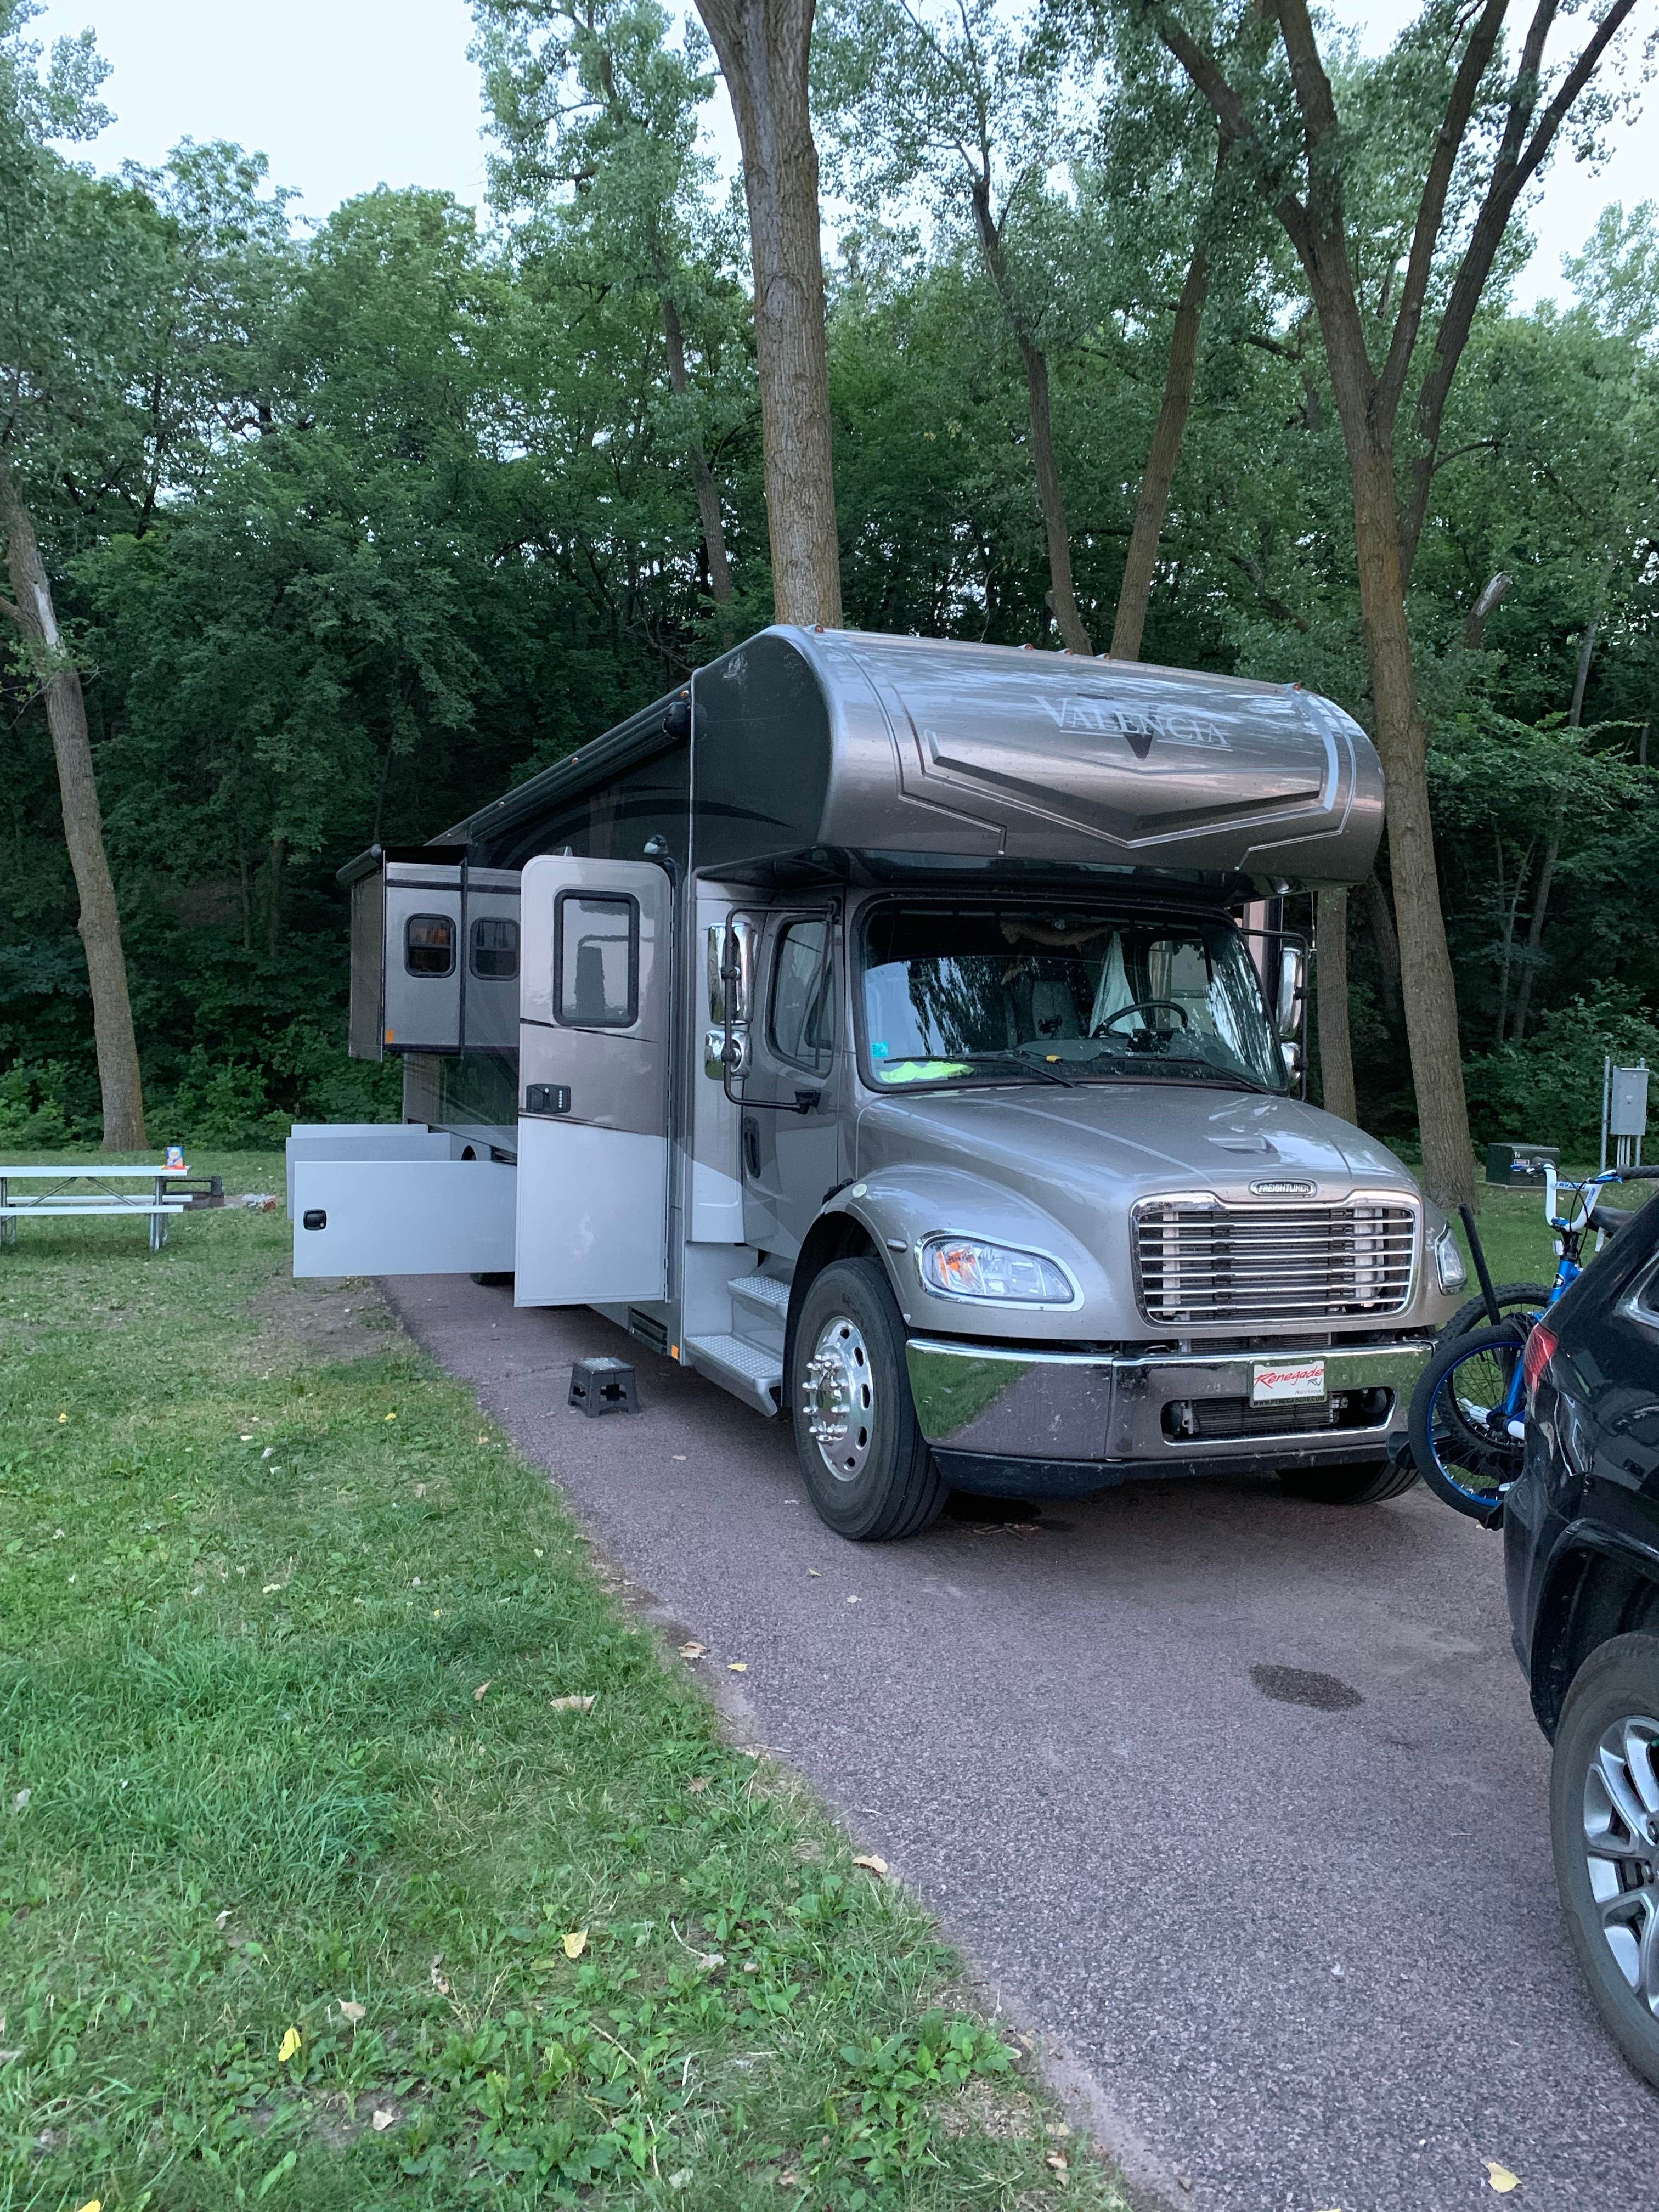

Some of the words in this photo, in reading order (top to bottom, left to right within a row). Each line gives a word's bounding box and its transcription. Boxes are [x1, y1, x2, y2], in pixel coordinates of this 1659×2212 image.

[1030, 696, 1230, 746] VALENCIA
[1259, 1183, 1309, 1192] FREIGHTLINER
[1254, 1366, 1325, 1389] Renegade
[1307, 1378, 1322, 1386] RV
[1254, 1396, 1325, 1406] WWW.RENEGADERV.COM
